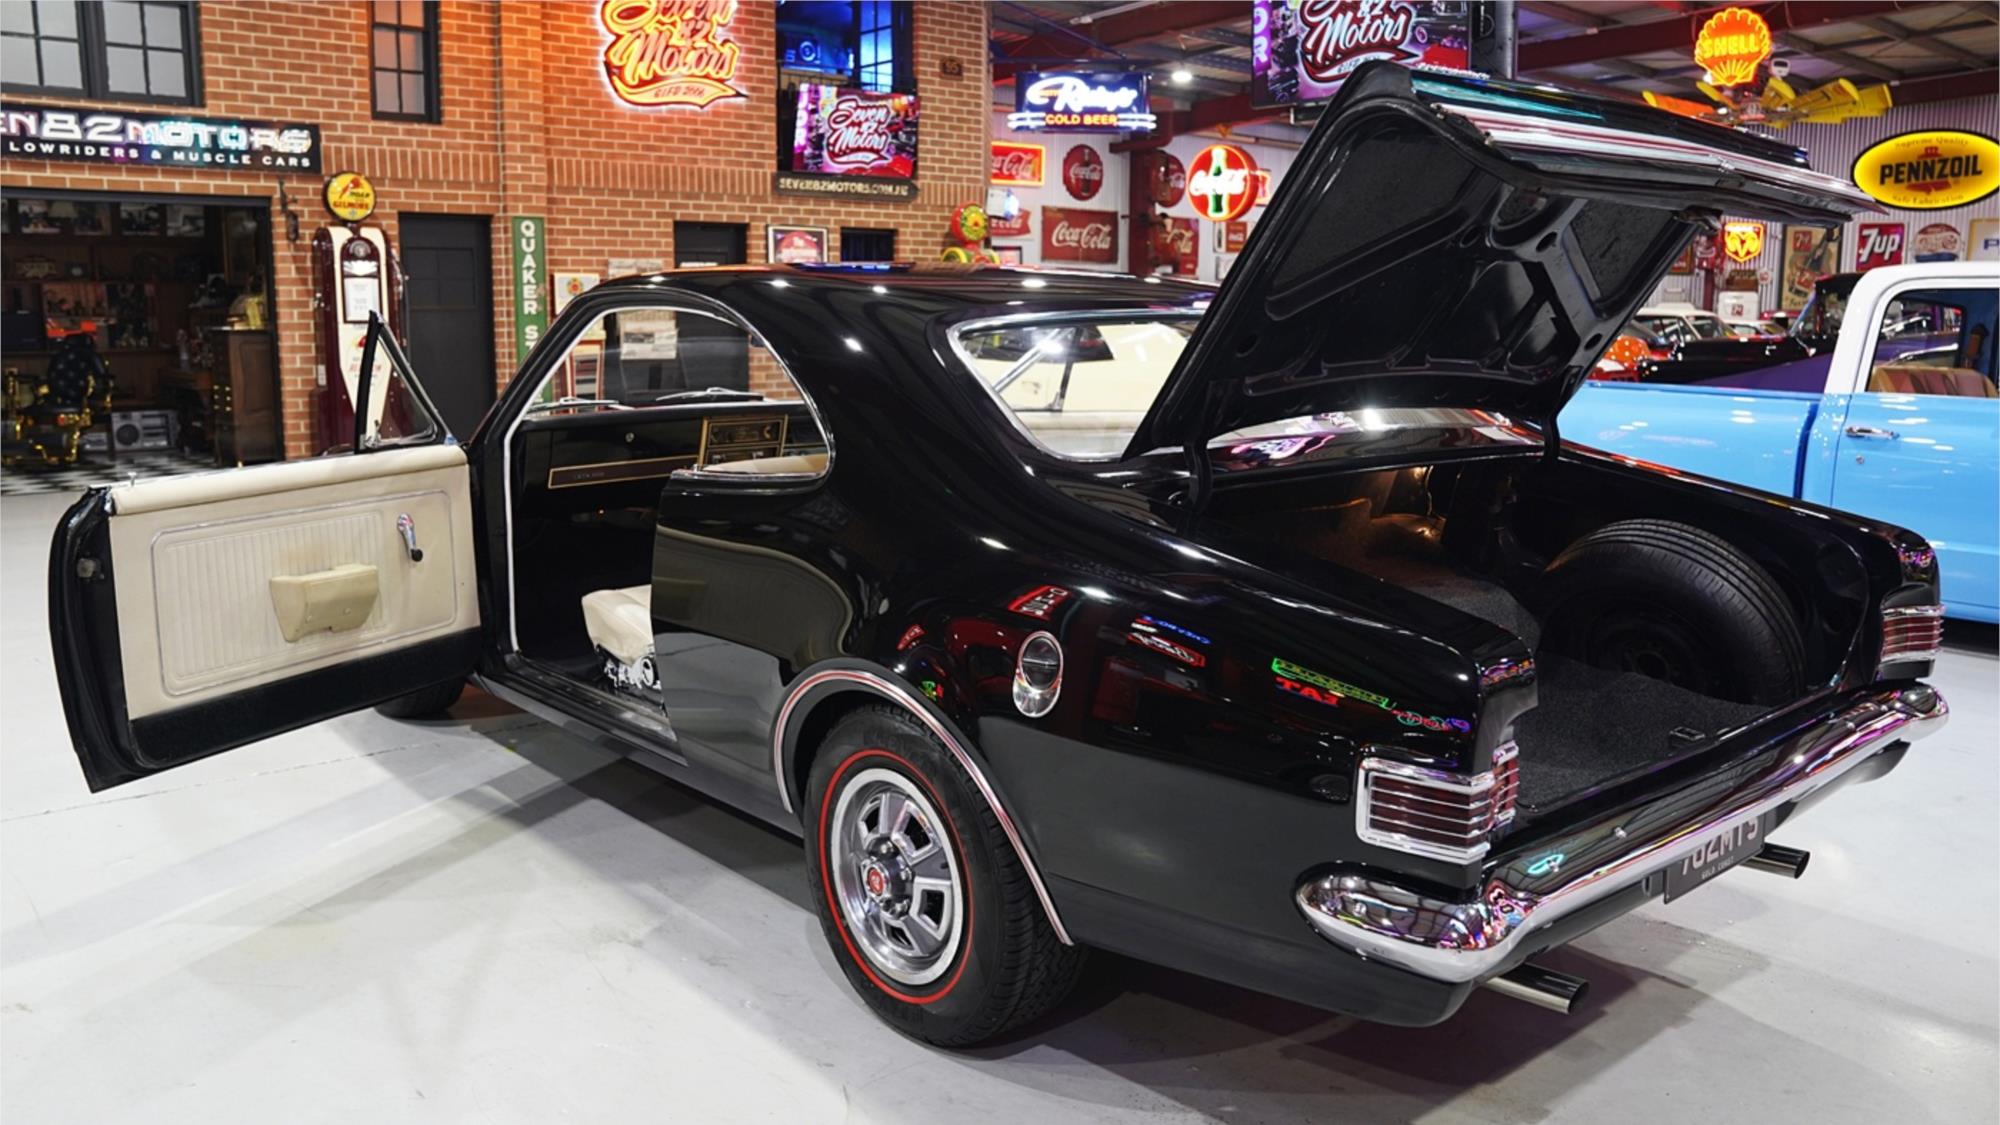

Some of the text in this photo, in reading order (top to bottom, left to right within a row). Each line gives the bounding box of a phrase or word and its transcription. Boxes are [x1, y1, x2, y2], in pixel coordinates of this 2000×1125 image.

[1306, 13, 1406, 64] Motors
[1702, 33, 1760, 58] SHELL
[611, 30, 738, 85] Motors
[830, 101, 888, 129] Seven
[1045, 114, 1119, 126] COLD BEER
[828, 126, 887, 153] Motors
[9, 142, 311, 167] LOWRIDERS & MUSCLE CARS
[1879, 154, 1983, 185] PENNZOIL
[1858, 227, 1901, 263] 7up
[520, 220, 538, 315] QUAKER
